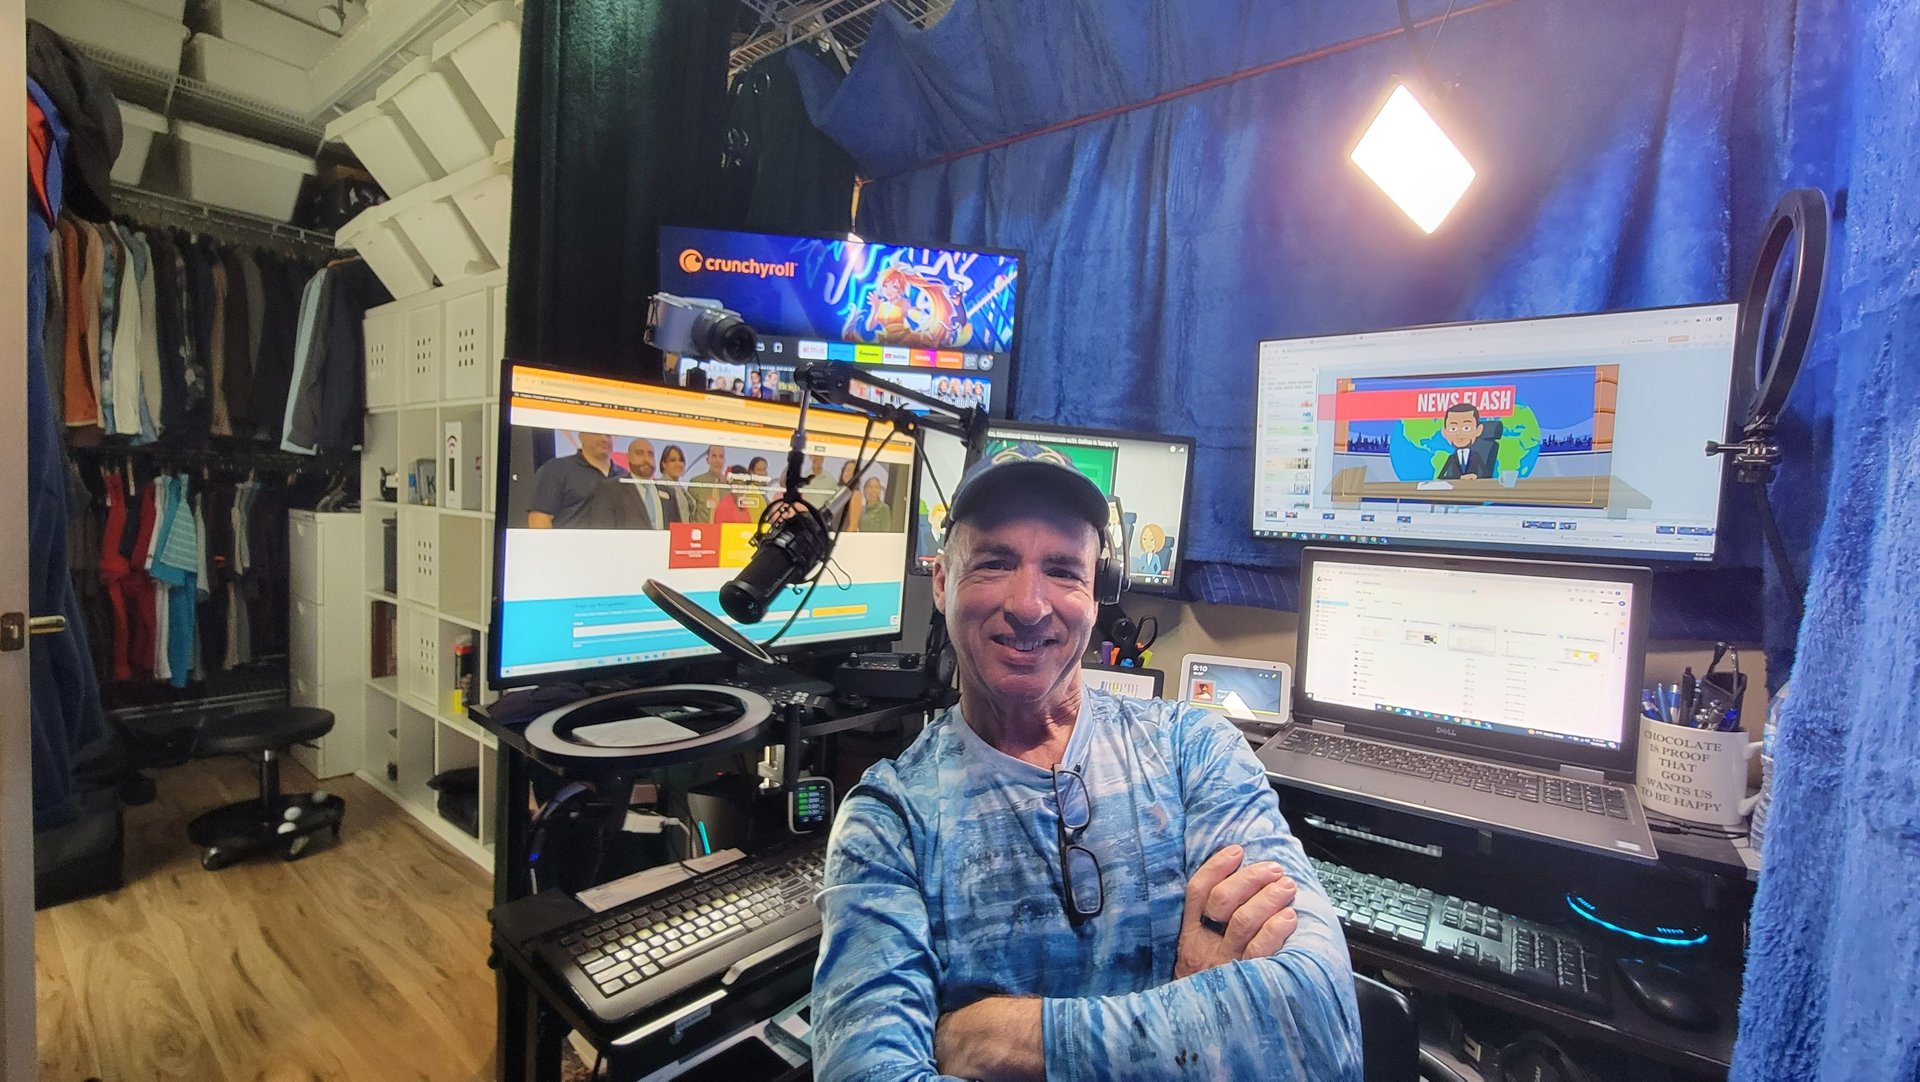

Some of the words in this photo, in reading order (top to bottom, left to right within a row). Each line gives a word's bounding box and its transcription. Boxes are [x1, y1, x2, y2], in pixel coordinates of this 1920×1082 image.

[705, 258, 795, 278] crunchyroll
[1417, 391, 1460, 413] NEWS
[1463, 390, 1512, 411] FLASH
[1436, 726, 1457, 736] DELL
[1644, 731, 1722, 752] CHOCOLATE
[1650, 743, 1660, 753] IS
[1662, 746, 1711, 762] PROOF
[1658, 757, 1697, 773] THAT
[1661, 770, 1693, 784] GOD
[1646, 777, 1691, 796] WANTS
[1695, 788, 1713, 799] US
[1640, 786, 1653, 799] TO
[1655, 792, 1671, 804] BE
[1673, 795, 1722, 812] HAPPY
